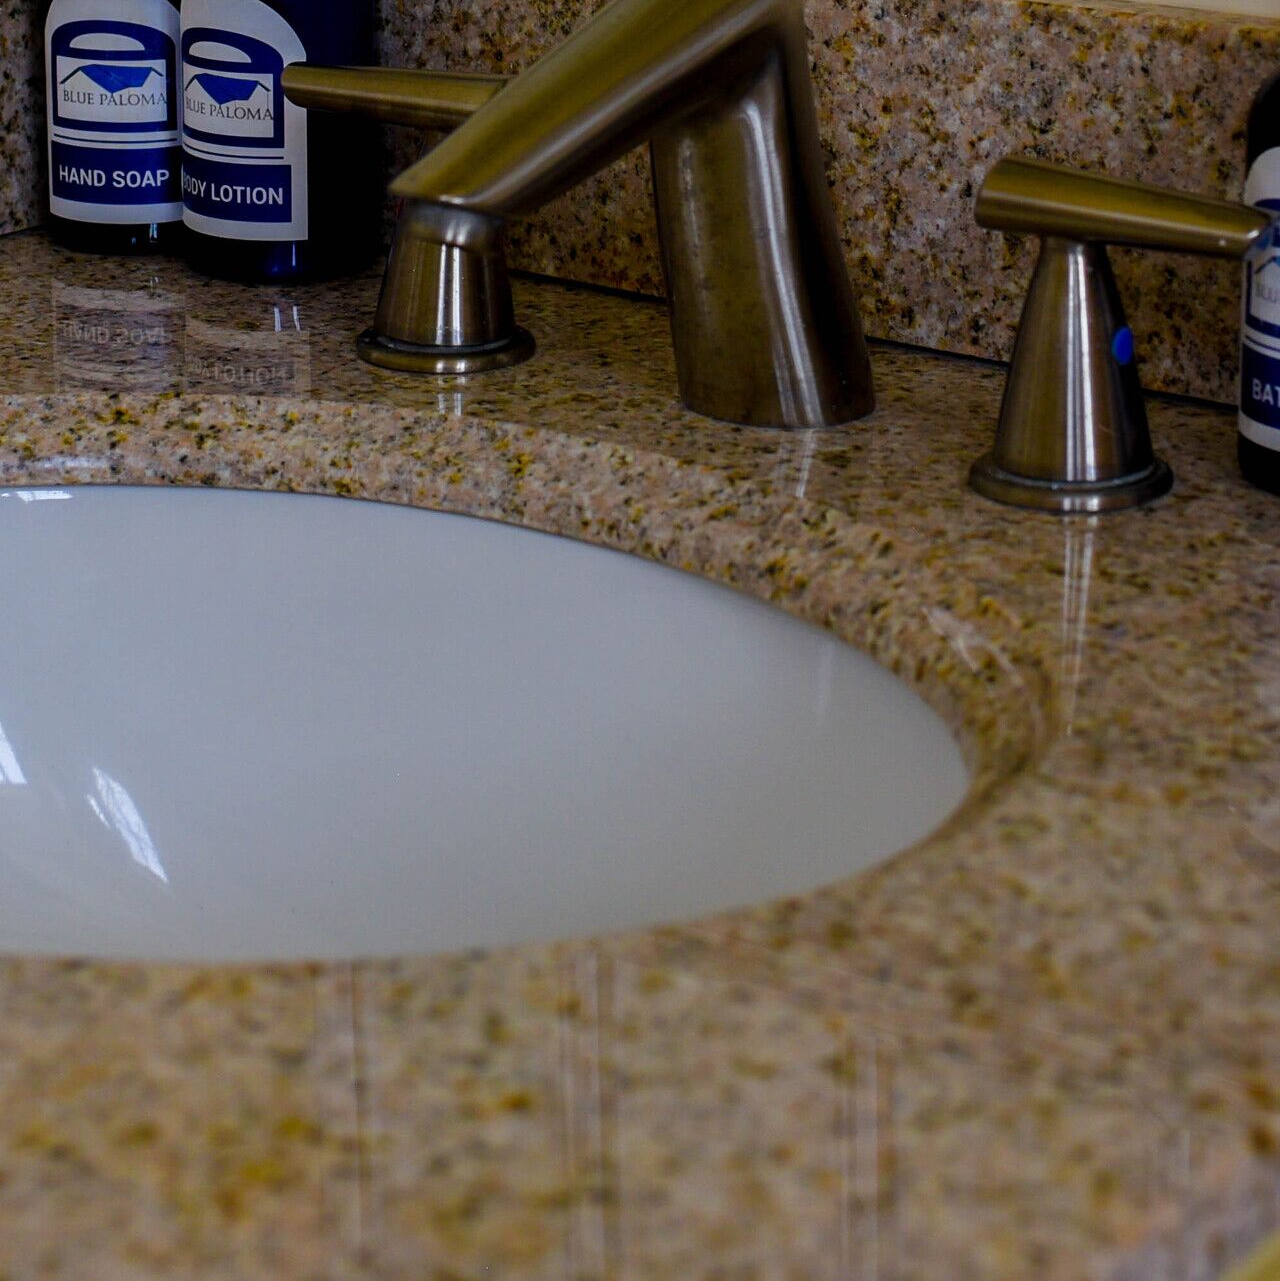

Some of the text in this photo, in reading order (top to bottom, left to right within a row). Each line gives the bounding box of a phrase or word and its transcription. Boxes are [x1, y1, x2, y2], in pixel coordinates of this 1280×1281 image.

[63, 90, 168, 107] BLUE PALOMA
[186, 97, 274, 121] BLUE PALOMA
[59, 164, 170, 188] HAND SOAP
[211, 183, 284, 206] LOTION
